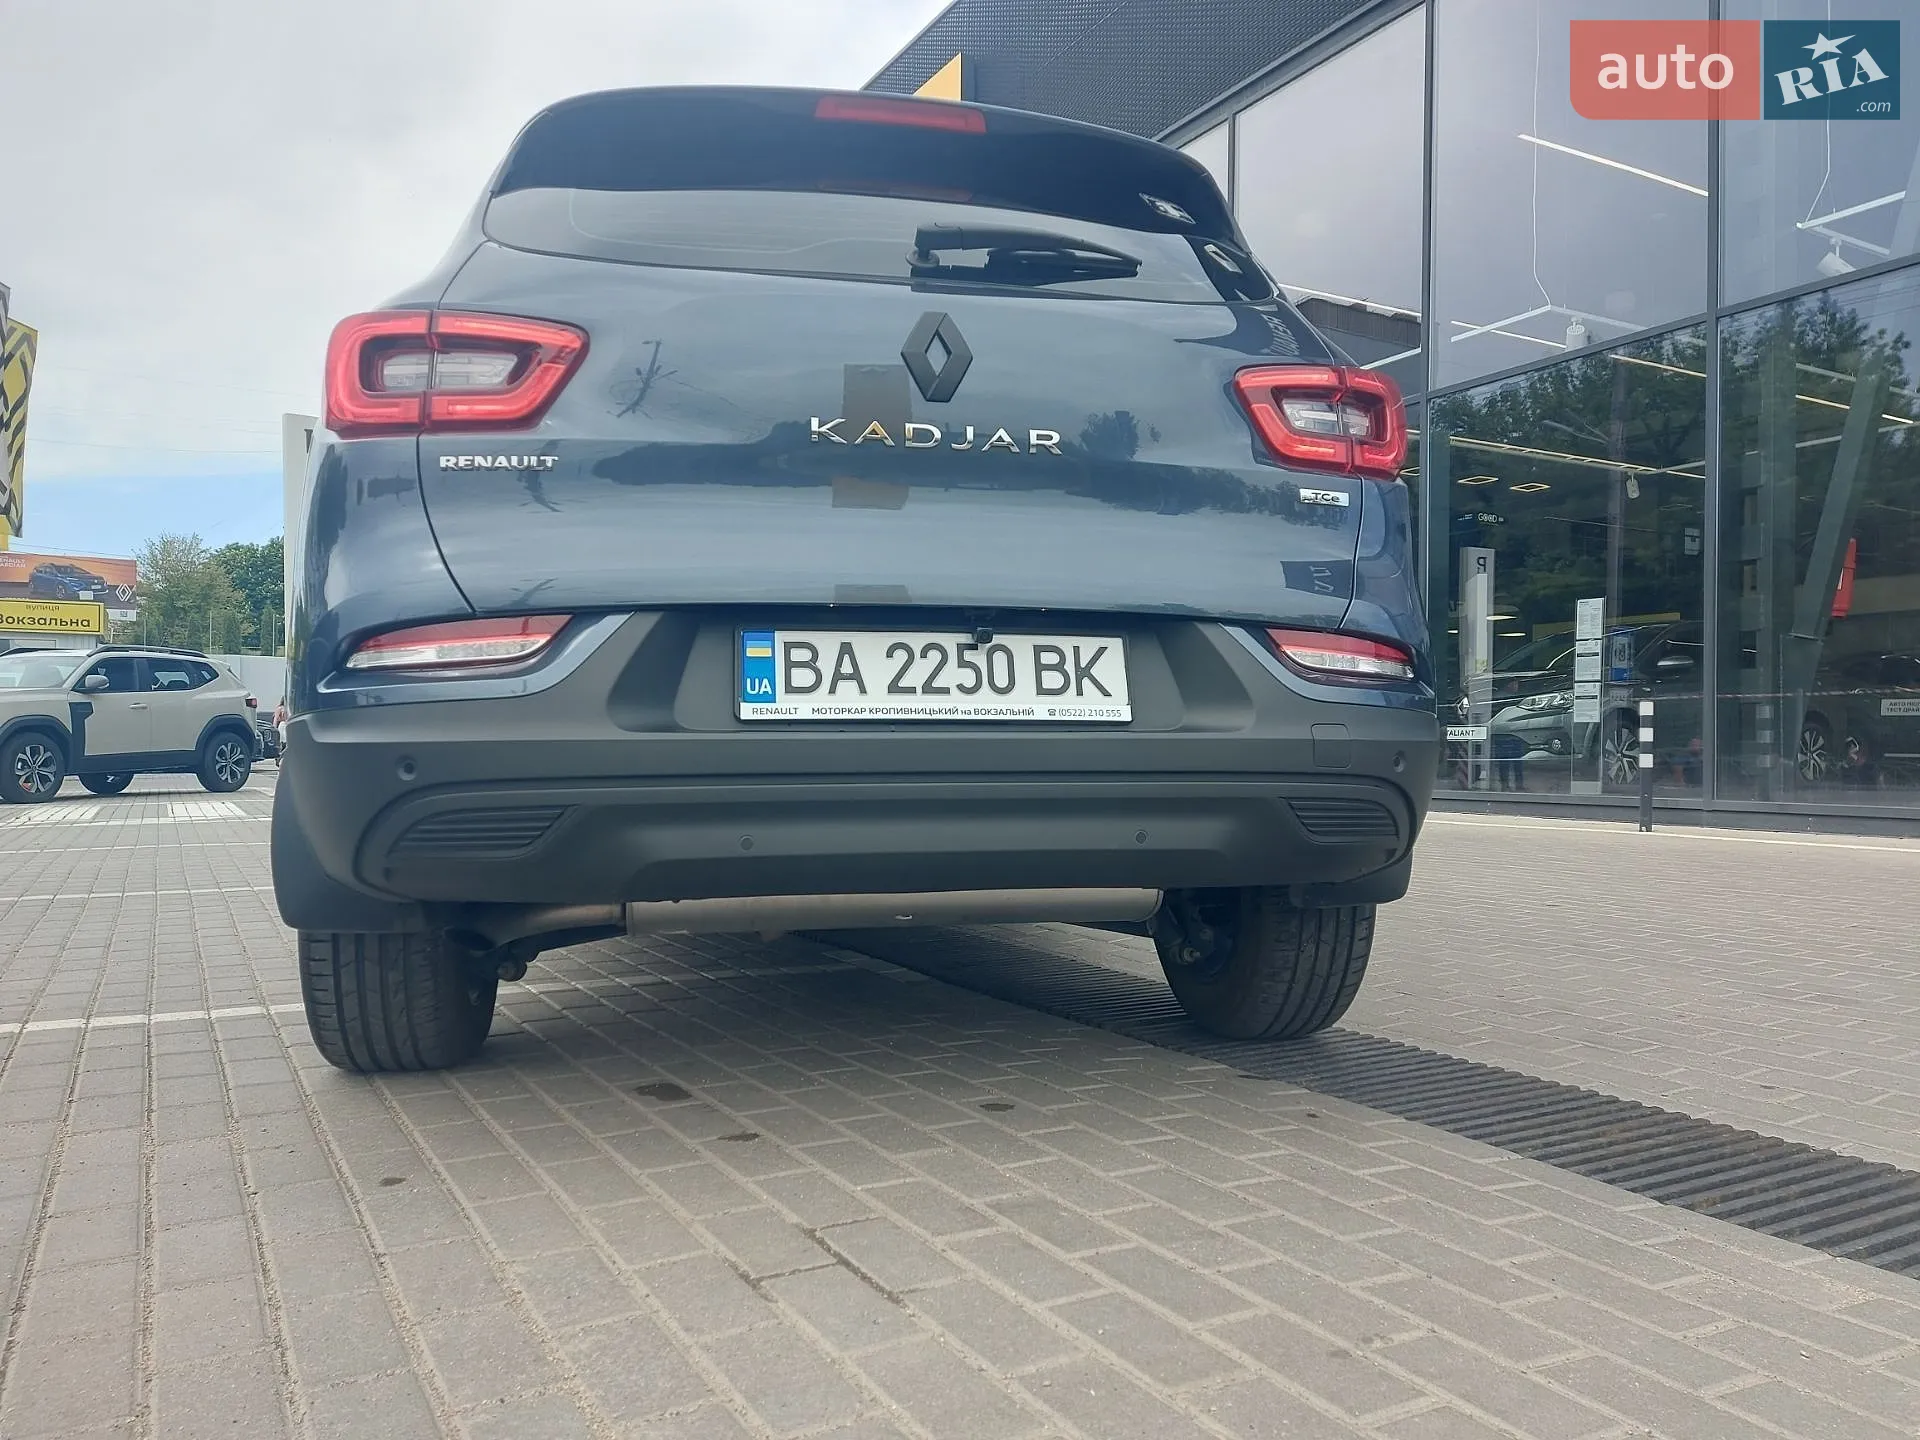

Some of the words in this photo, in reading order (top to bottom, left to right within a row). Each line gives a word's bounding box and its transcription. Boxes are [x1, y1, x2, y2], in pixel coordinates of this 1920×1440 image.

[810, 416, 1063, 455] KADJAR
[439, 455, 559, 470] RENAULT
[1311, 492, 1341, 503] TCe
[25, 603, 60, 612] вулиця
[783, 641, 868, 695] BA
[886, 641, 1016, 695] 2250
[1032, 644, 1113, 697] BK
[746, 677, 772, 695] UA
[752, 707, 800, 715] RENAULT
[812, 707, 867, 715] МОТОРКАР
[868, 706, 959, 717] КРОПИВНИЦЬКИЙ
[973, 707, 1035, 717] ВОКЗАЛЬНІЙ
[1058, 708, 1086, 718] (0522)
[1087, 708, 1104, 718] 210
[1105, 709, 1122, 718] 555
